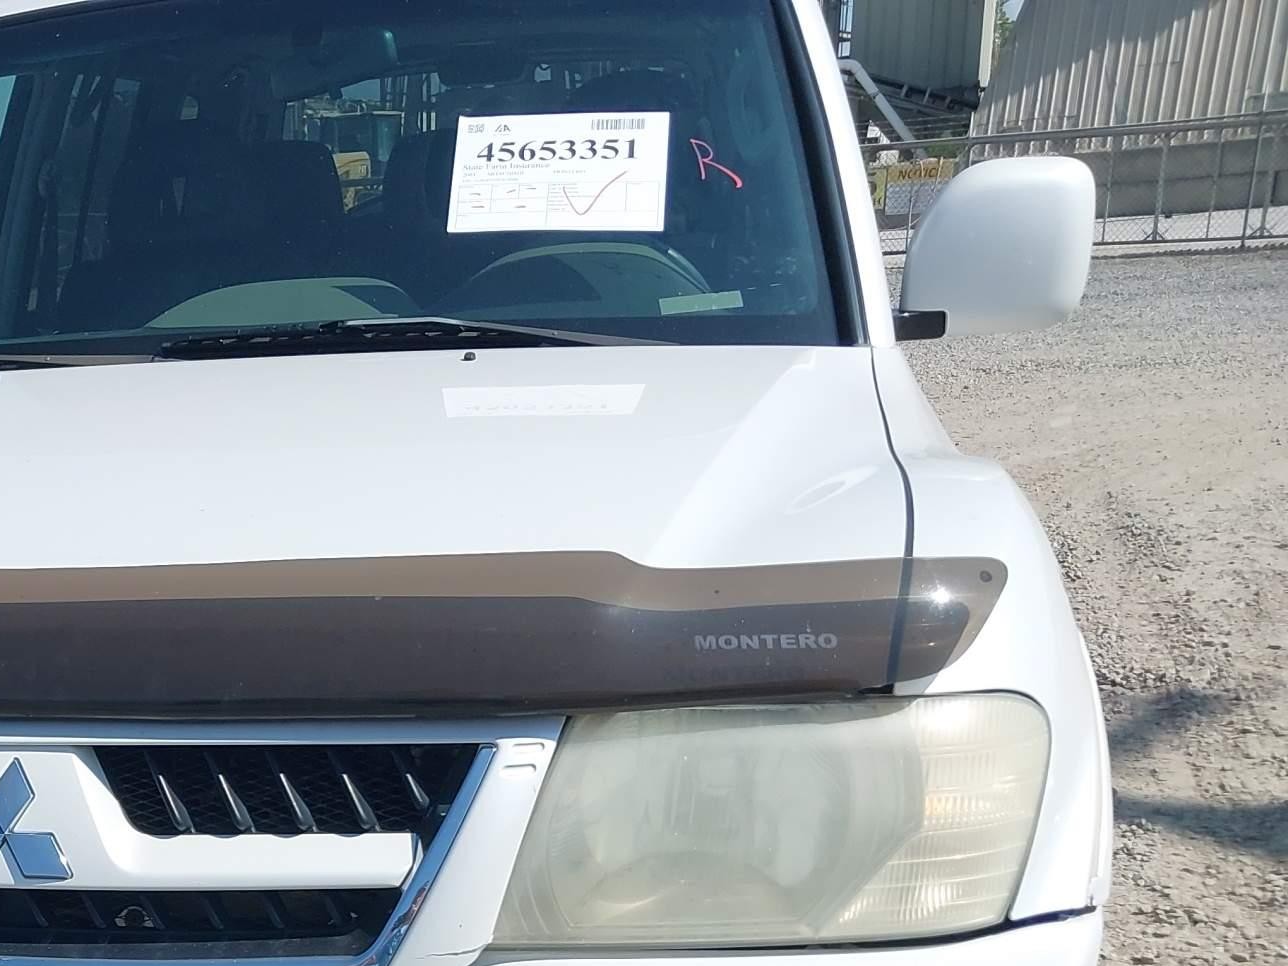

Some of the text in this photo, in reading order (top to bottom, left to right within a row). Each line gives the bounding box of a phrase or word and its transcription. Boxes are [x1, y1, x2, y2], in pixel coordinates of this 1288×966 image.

[476, 138, 638, 162] 45653351
[689, 138, 743, 189] R
[694, 632, 838, 651] MONTERO
